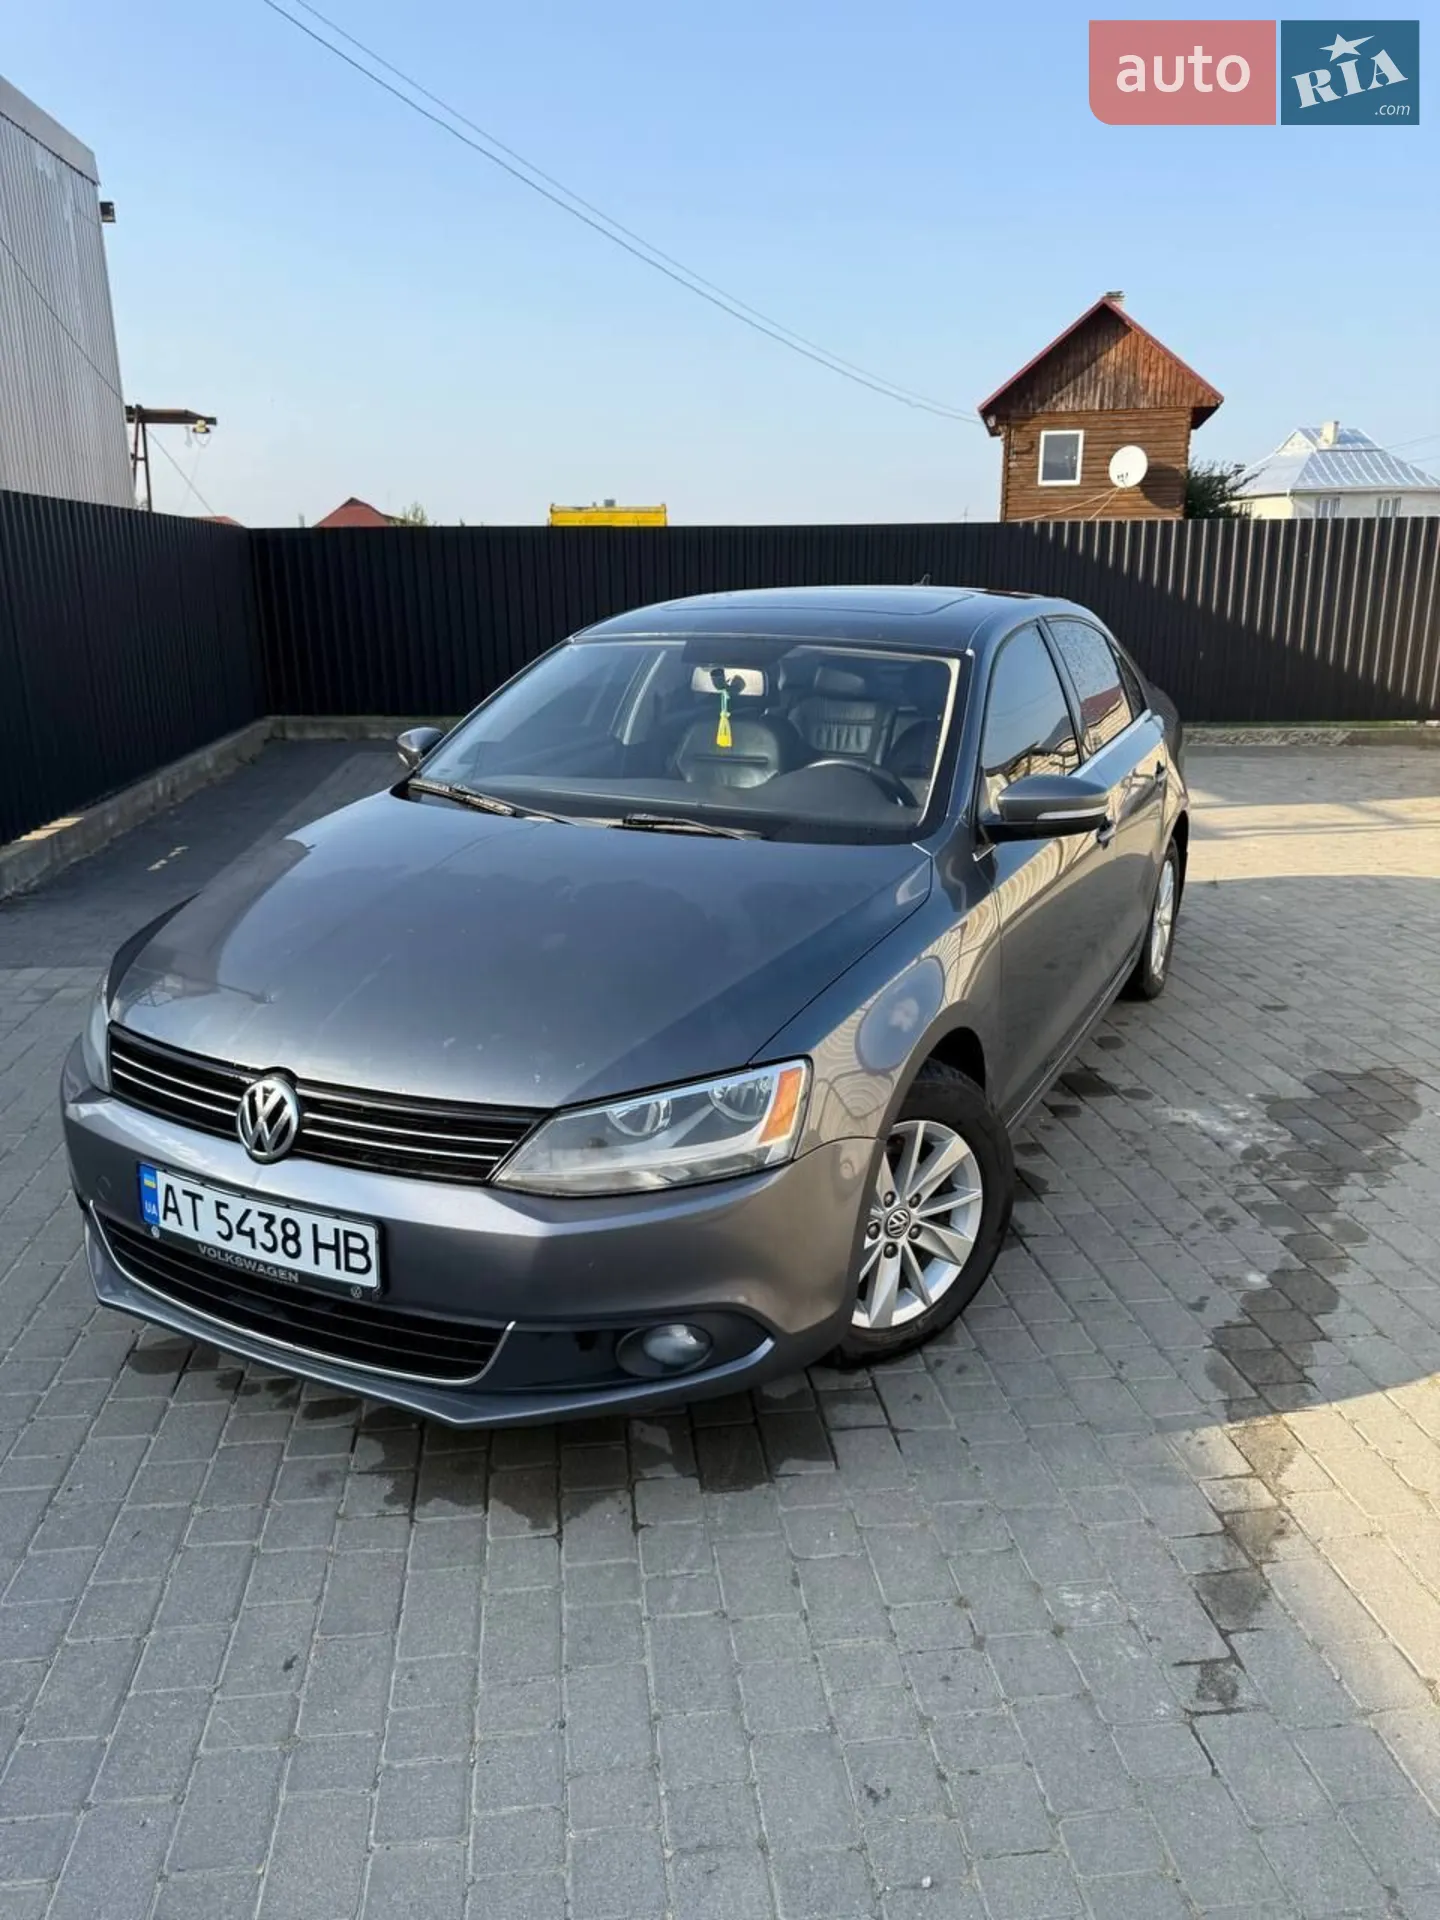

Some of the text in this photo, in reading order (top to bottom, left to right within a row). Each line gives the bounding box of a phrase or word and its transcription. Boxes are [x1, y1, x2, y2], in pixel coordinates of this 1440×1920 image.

[144, 1200, 158, 1217] UA
[163, 1183, 372, 1275] AT 5438 HB
[197, 1243, 299, 1283] VOLKSWAGEN
